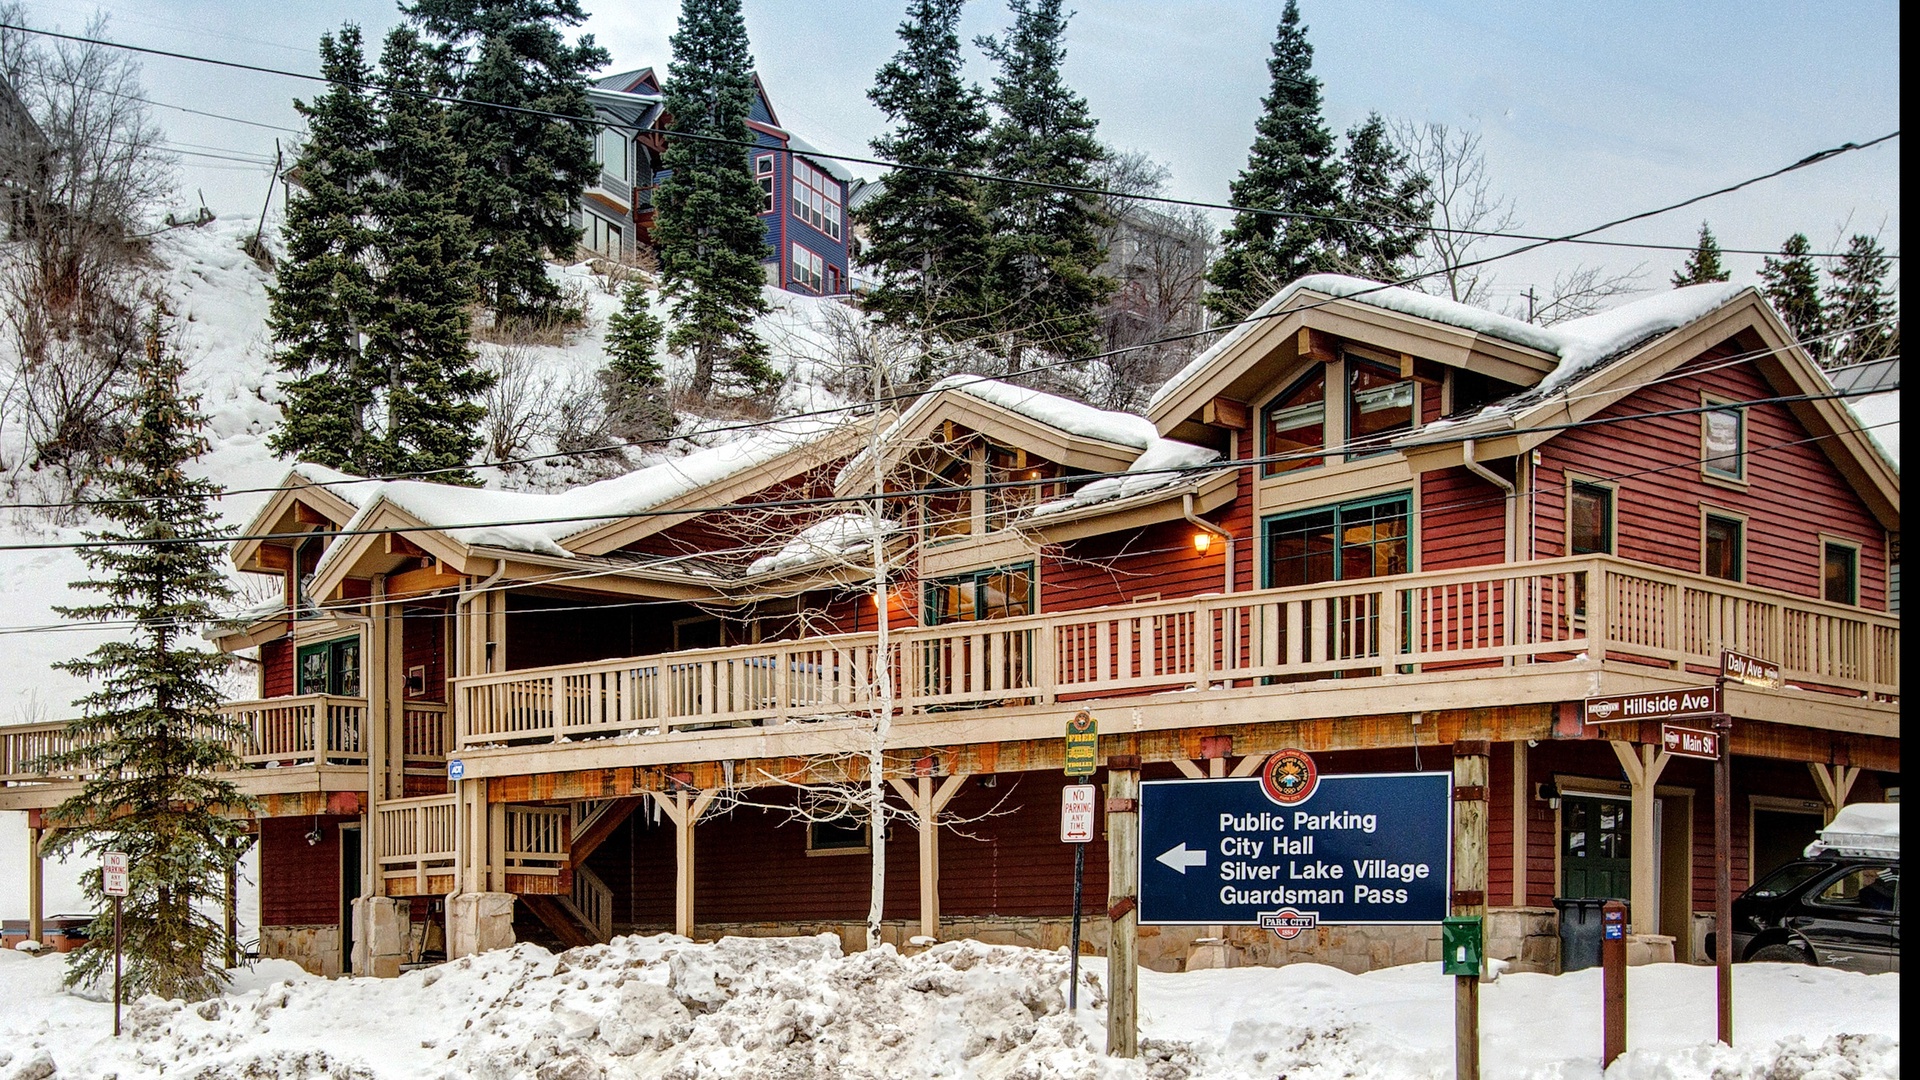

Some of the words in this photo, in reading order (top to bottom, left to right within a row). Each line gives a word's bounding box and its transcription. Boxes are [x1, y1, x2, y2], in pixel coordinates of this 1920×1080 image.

[1728, 653, 1746, 677] Daly
[1747, 660, 1763, 678] Ave
[1624, 695, 1677, 715] Hillside
[1681, 693, 1709, 710] Ave
[1069, 733, 1094, 742] FREE
[1683, 733, 1702, 752] Main
[1073, 790, 1085, 801] NO
[1065, 803, 1092, 813] PARKING
[1070, 822, 1085, 830] TIME
[1220, 812, 1285, 831] Public
[1294, 810, 1377, 833] Parking
[1220, 836, 1264, 859] City
[1273, 836, 1314, 855] Hall
[111, 856, 120, 865] NO
[105, 866, 126, 874] PARKING
[1220, 860, 1281, 881] Silver
[1289, 860, 1344, 880] Lake
[1353, 859, 1430, 883] Village
[1220, 885, 1344, 905] Guardsman
[1354, 884, 1408, 904] Pass
[1265, 918, 1289, 926] PARK
[1290, 918, 1310, 926] CITY
